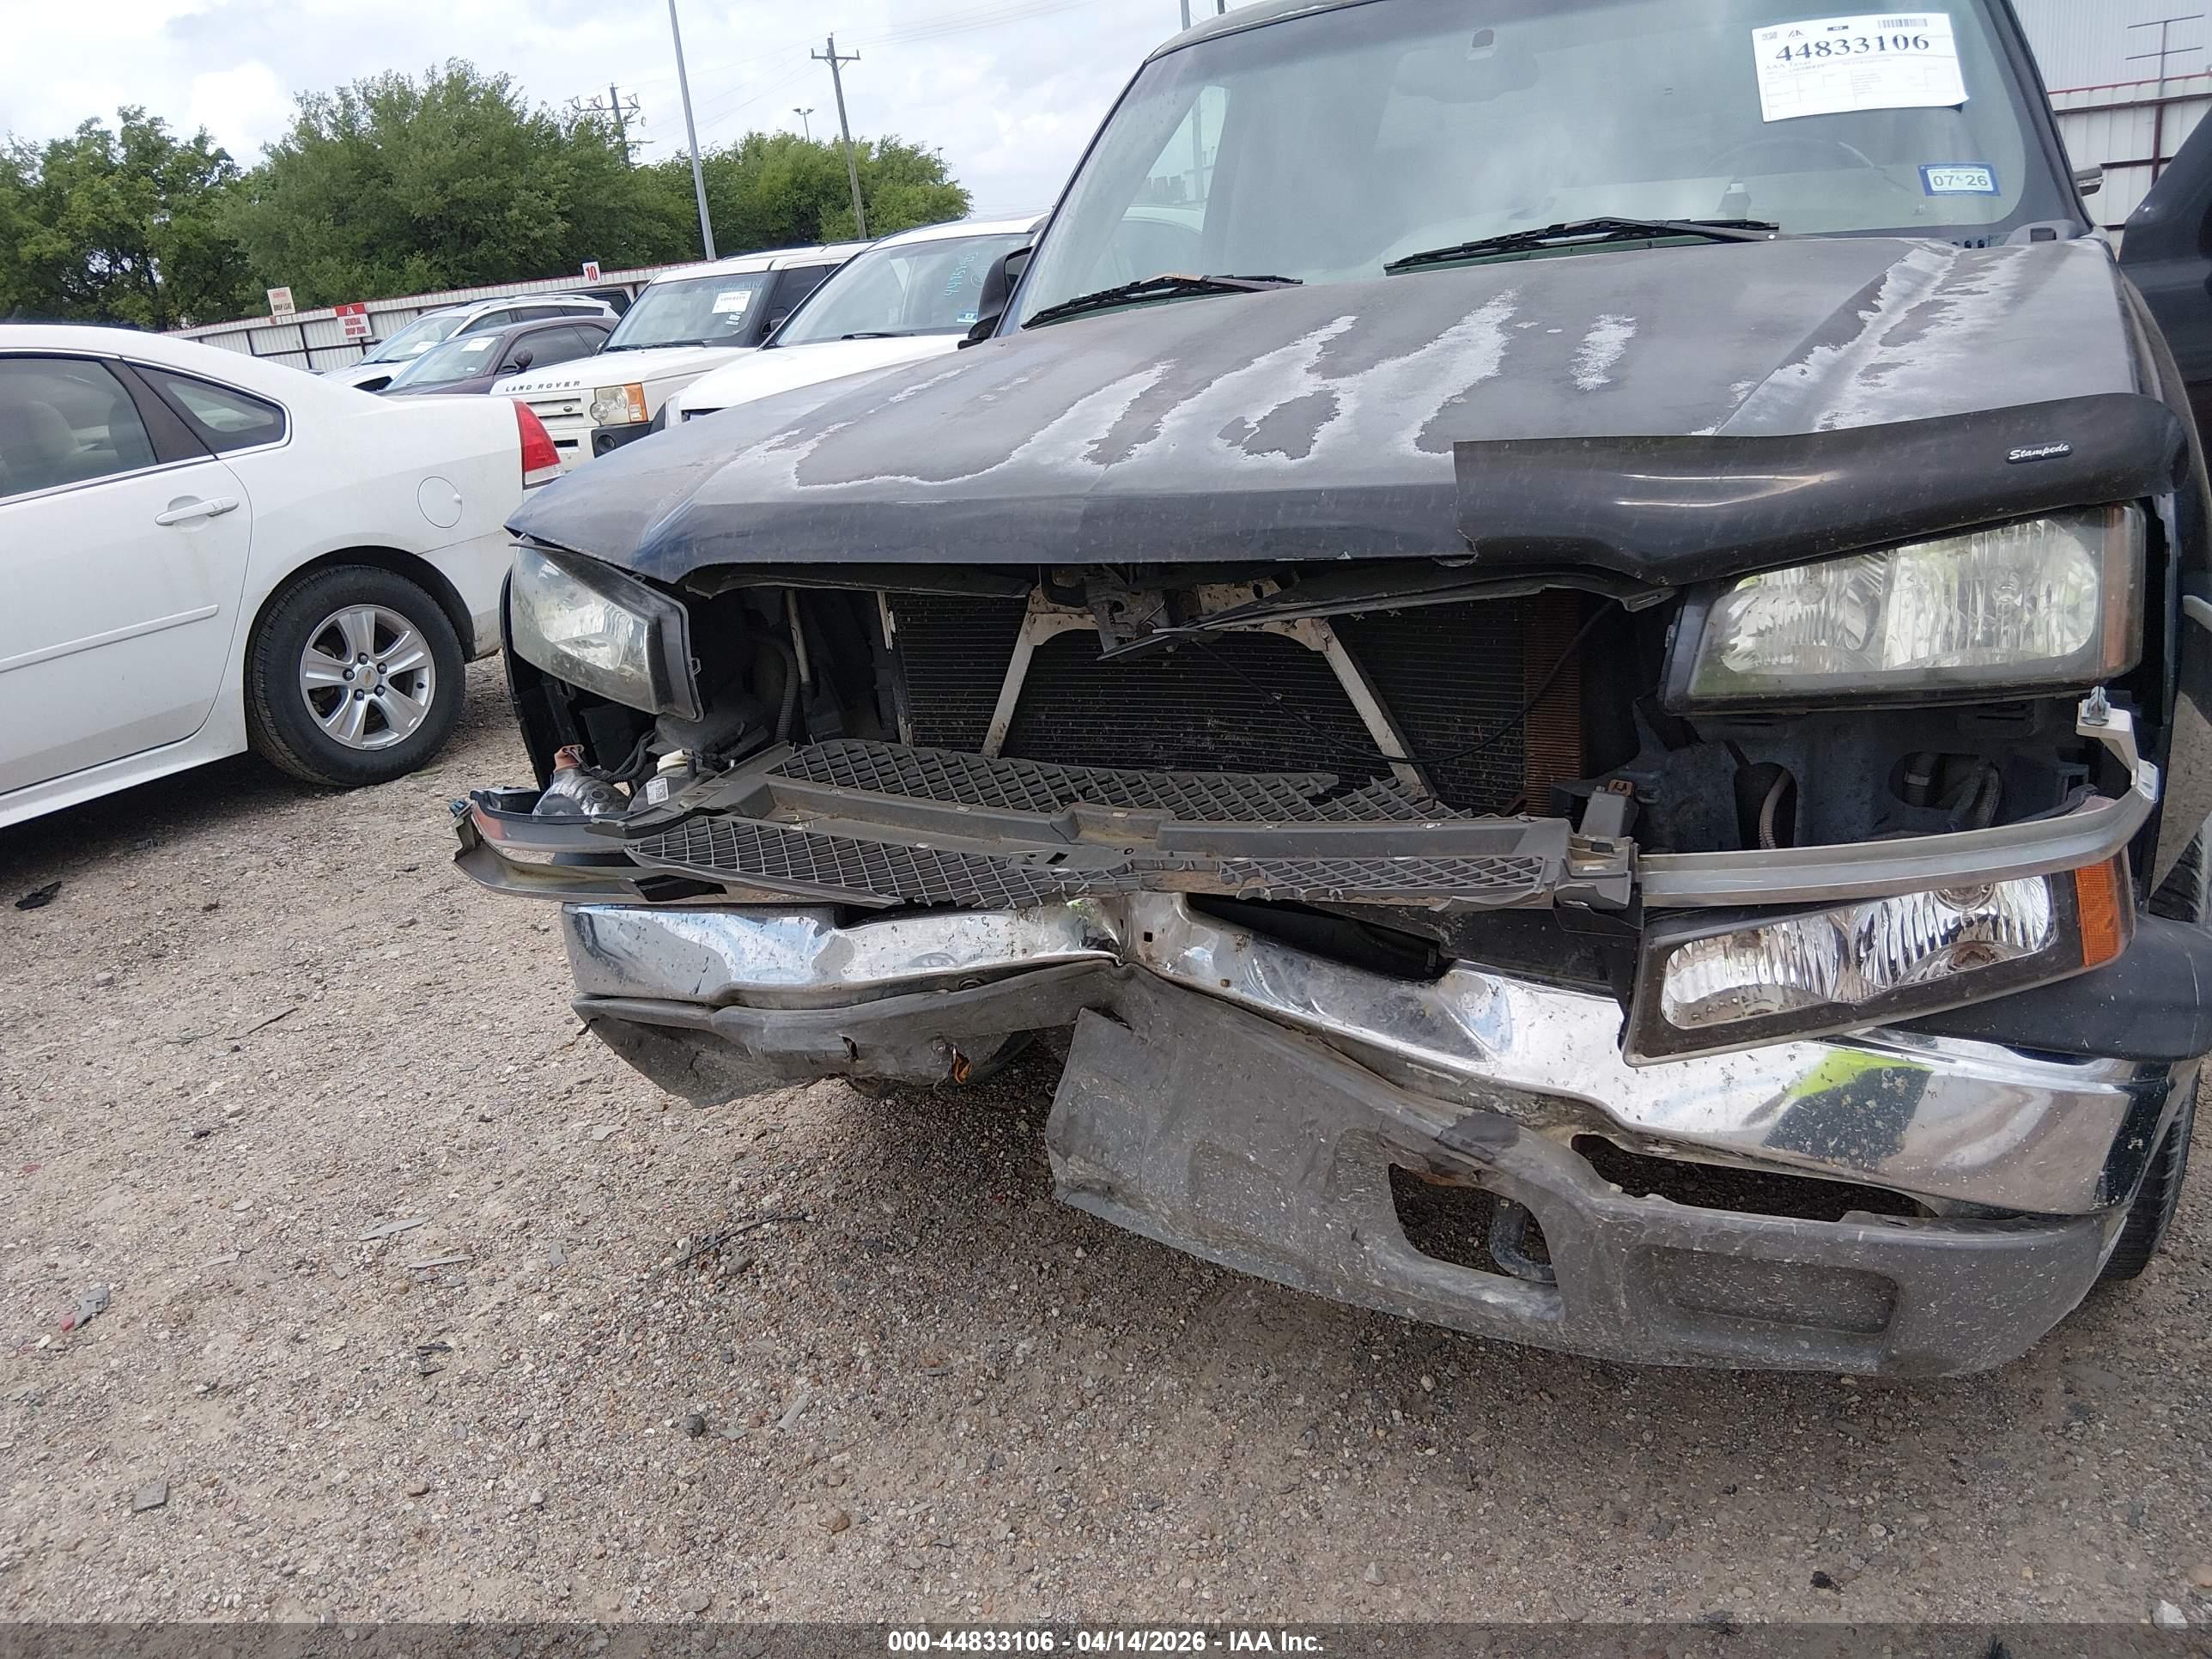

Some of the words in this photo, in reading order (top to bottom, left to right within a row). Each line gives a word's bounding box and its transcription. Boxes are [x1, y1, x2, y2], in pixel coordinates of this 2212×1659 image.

[1776, 34, 1929, 61] 44833106
[1933, 175, 1954, 186] 07
[1965, 174, 1989, 186] 26
[585, 265, 598, 282] 10
[505, 384, 532, 392] LAND
[538, 380, 580, 390] ROVER
[2008, 443, 2070, 460] Stampede
